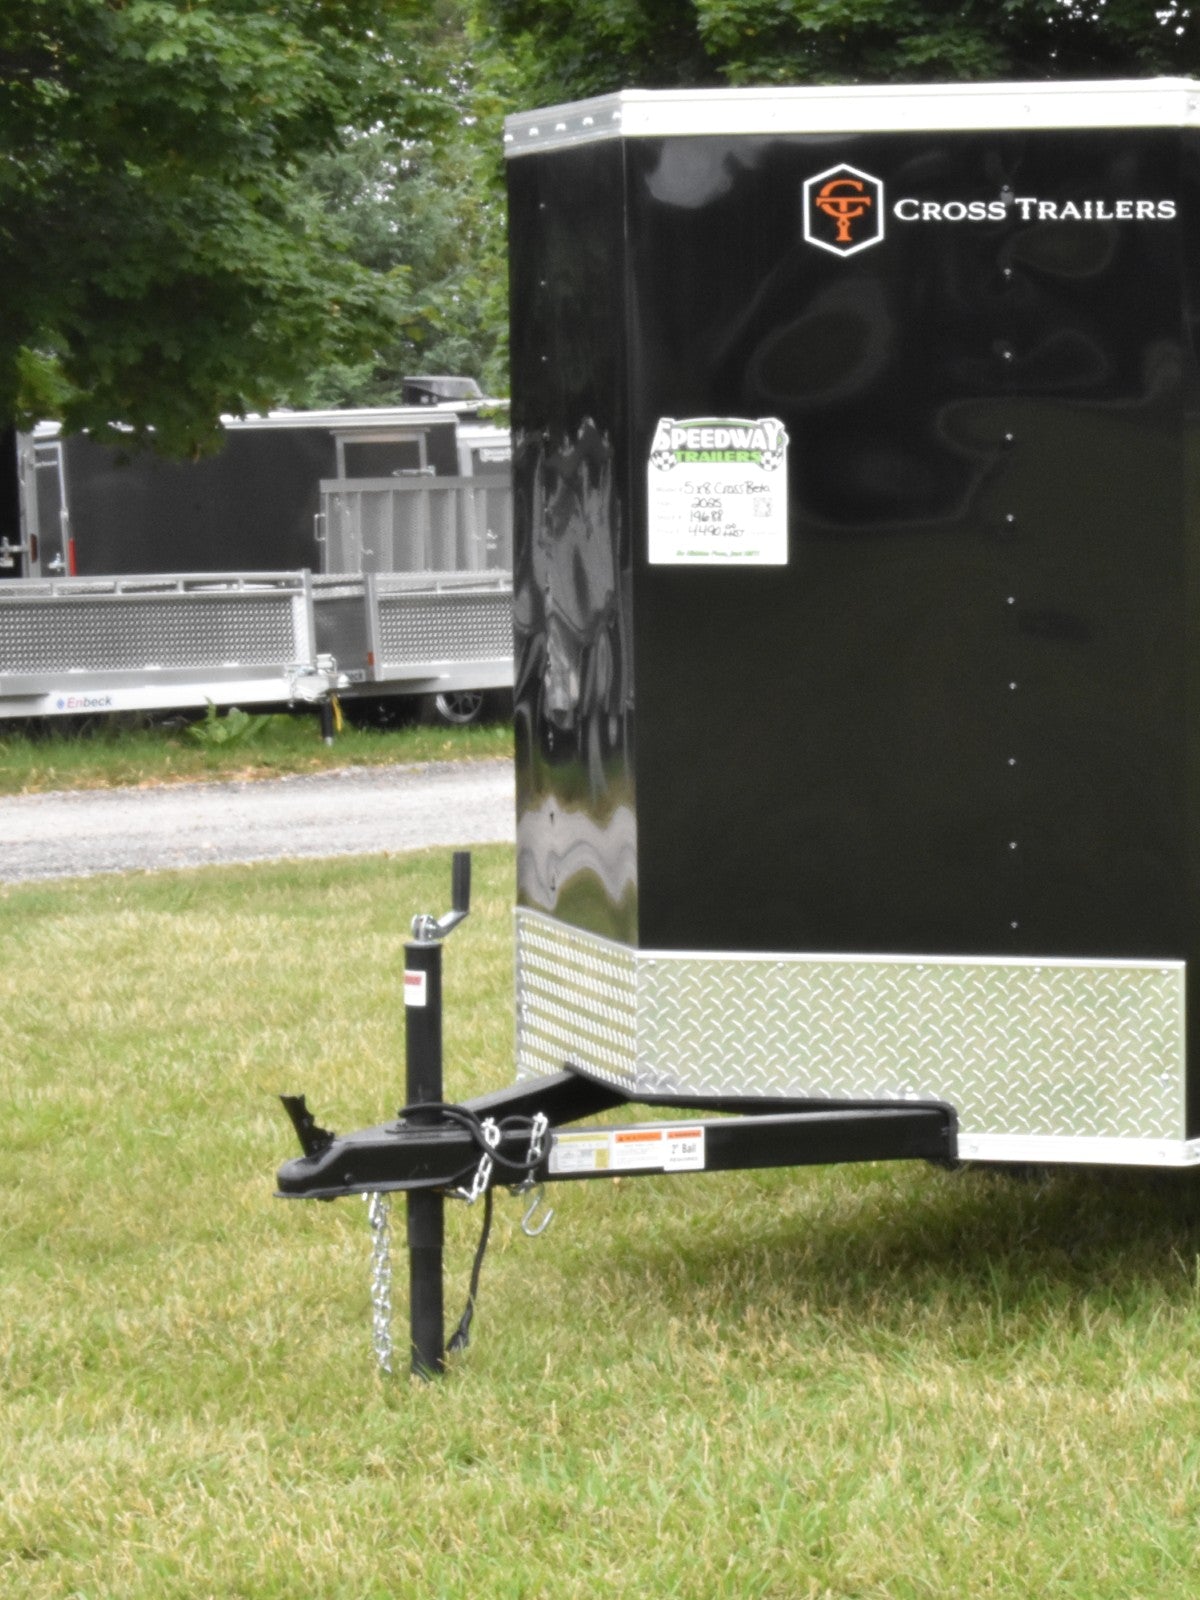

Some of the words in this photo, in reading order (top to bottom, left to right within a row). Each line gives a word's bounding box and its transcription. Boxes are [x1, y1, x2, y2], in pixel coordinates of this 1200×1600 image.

[652, 419, 784, 451] SPEEDWAY
[674, 450, 762, 462] TRAILERS
[714, 481, 744, 494] Cross
[67, 696, 112, 708] Enbeck
